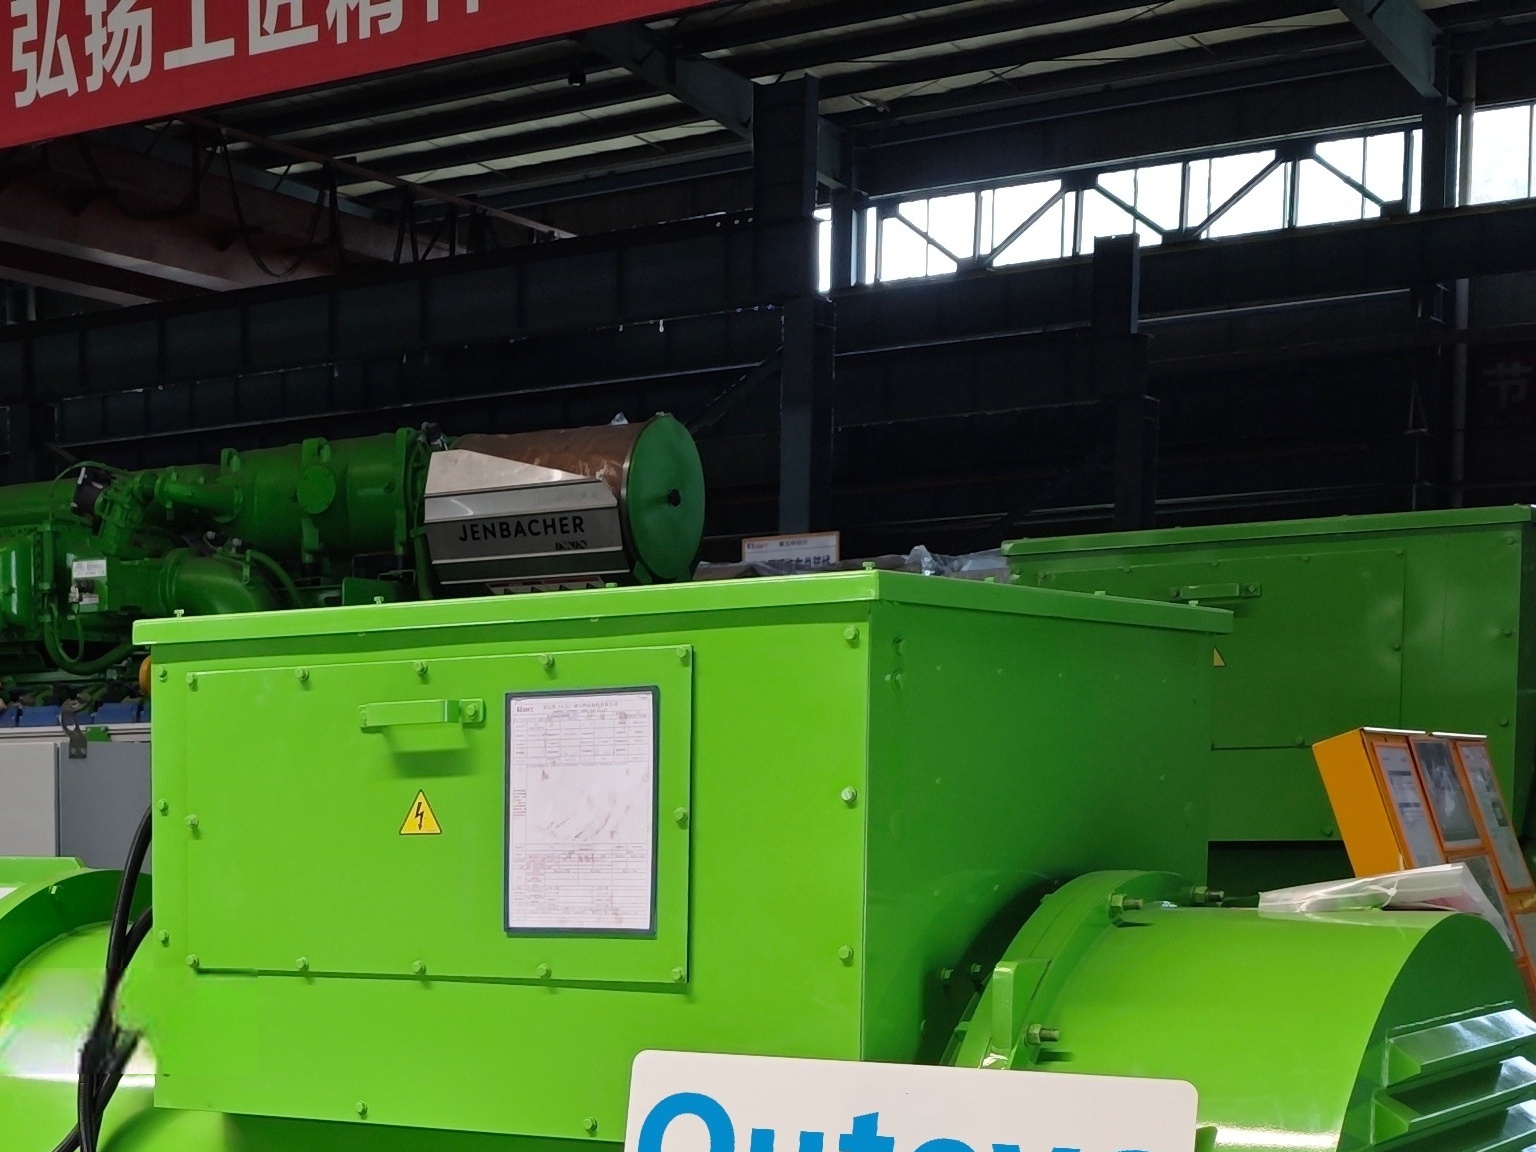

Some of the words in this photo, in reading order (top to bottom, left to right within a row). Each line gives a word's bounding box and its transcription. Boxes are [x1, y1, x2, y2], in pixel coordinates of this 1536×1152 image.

[10, 0, 481, 109] 弘扬工匠
[459, 516, 585, 541] JENBACHER
